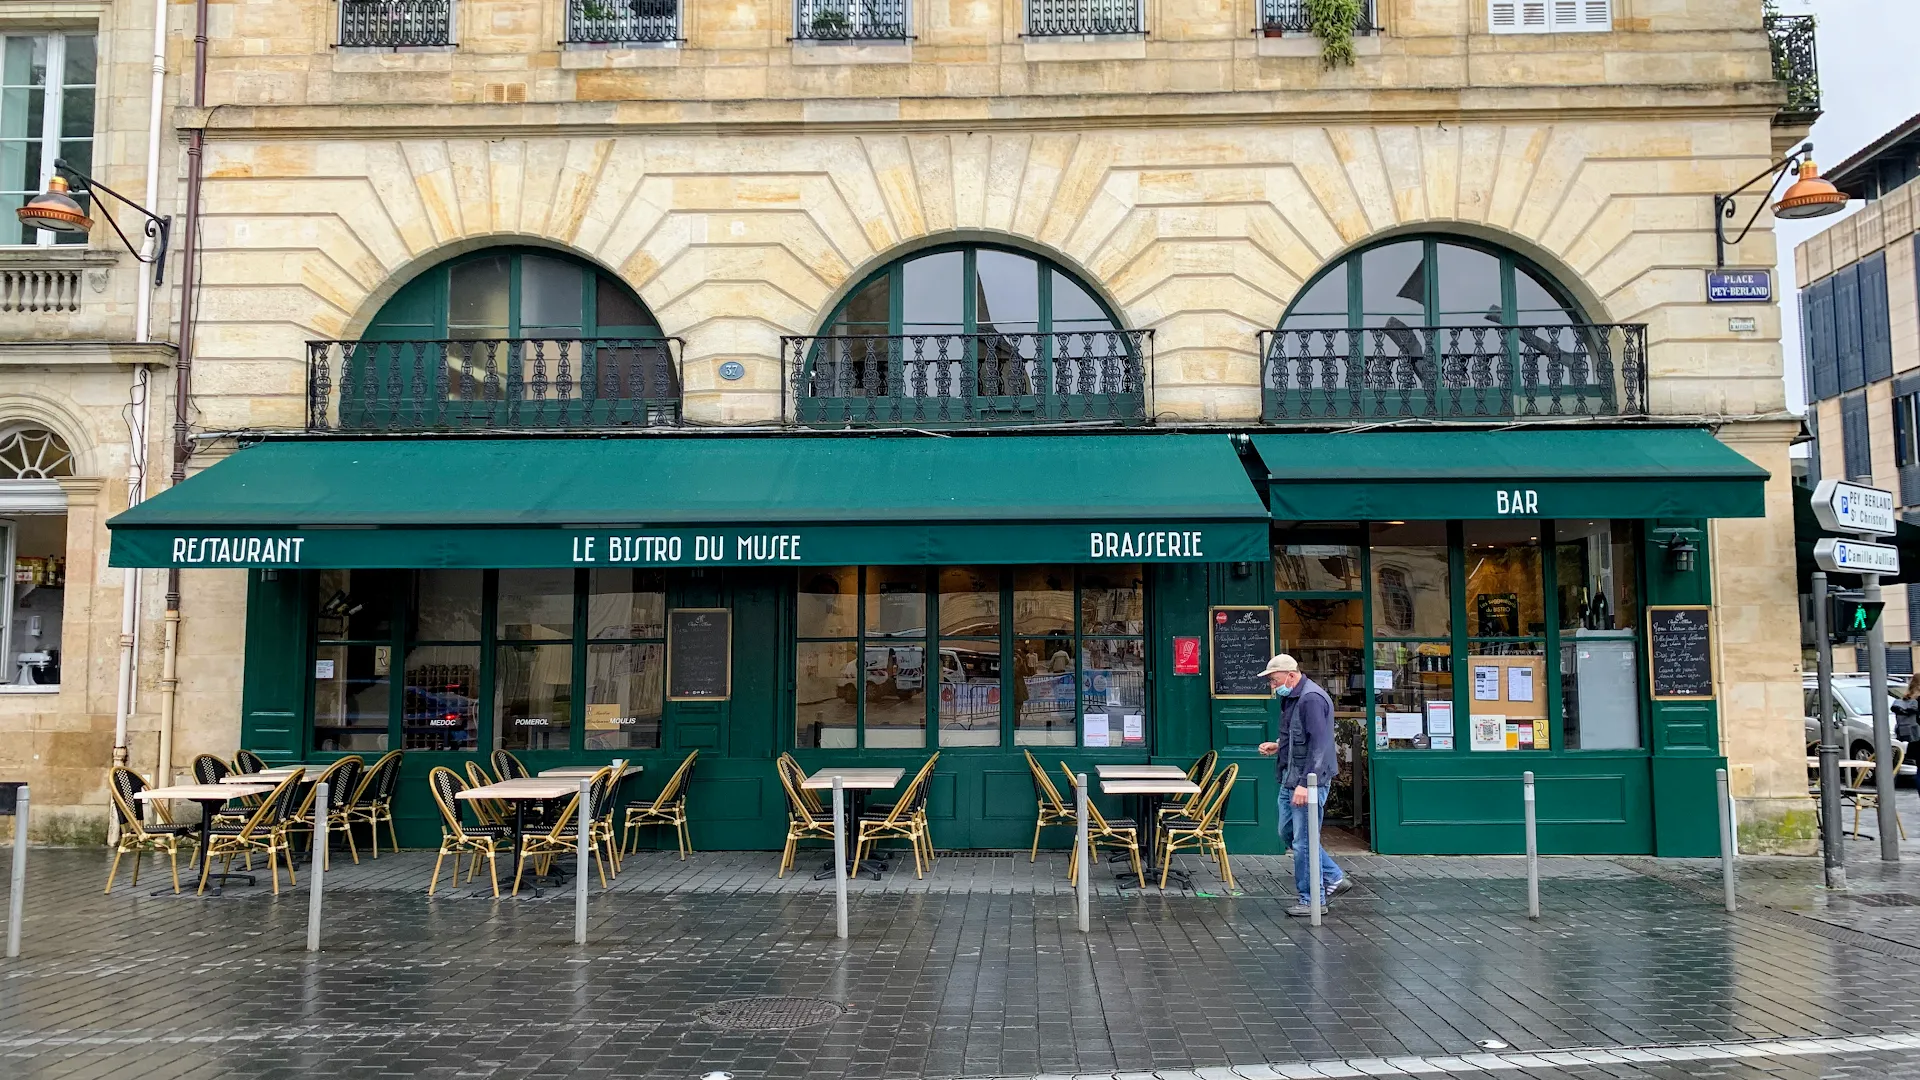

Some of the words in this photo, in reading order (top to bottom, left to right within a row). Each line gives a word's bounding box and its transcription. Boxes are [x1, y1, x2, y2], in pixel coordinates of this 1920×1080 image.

[1724, 274, 1754, 284] PLACE
[1712, 286, 1768, 296] PEY-BERLAND
[726, 364, 738, 376] 37
[1496, 490, 1539, 514] BAR
[1850, 491, 1860, 506] PEY
[1865, 494, 1892, 510] BERLAND
[1860, 510, 1887, 528] Christoly
[172, 537, 305, 563] RESTAURANT
[572, 536, 596, 562] LE
[609, 536, 682, 562] BISTRO
[695, 536, 724, 561] DU
[737, 534, 801, 560] MUSEE
[1090, 531, 1203, 558] BRASSERIE
[1848, 549, 1872, 564] Camille
[1875, 552, 1895, 566] Jullian
